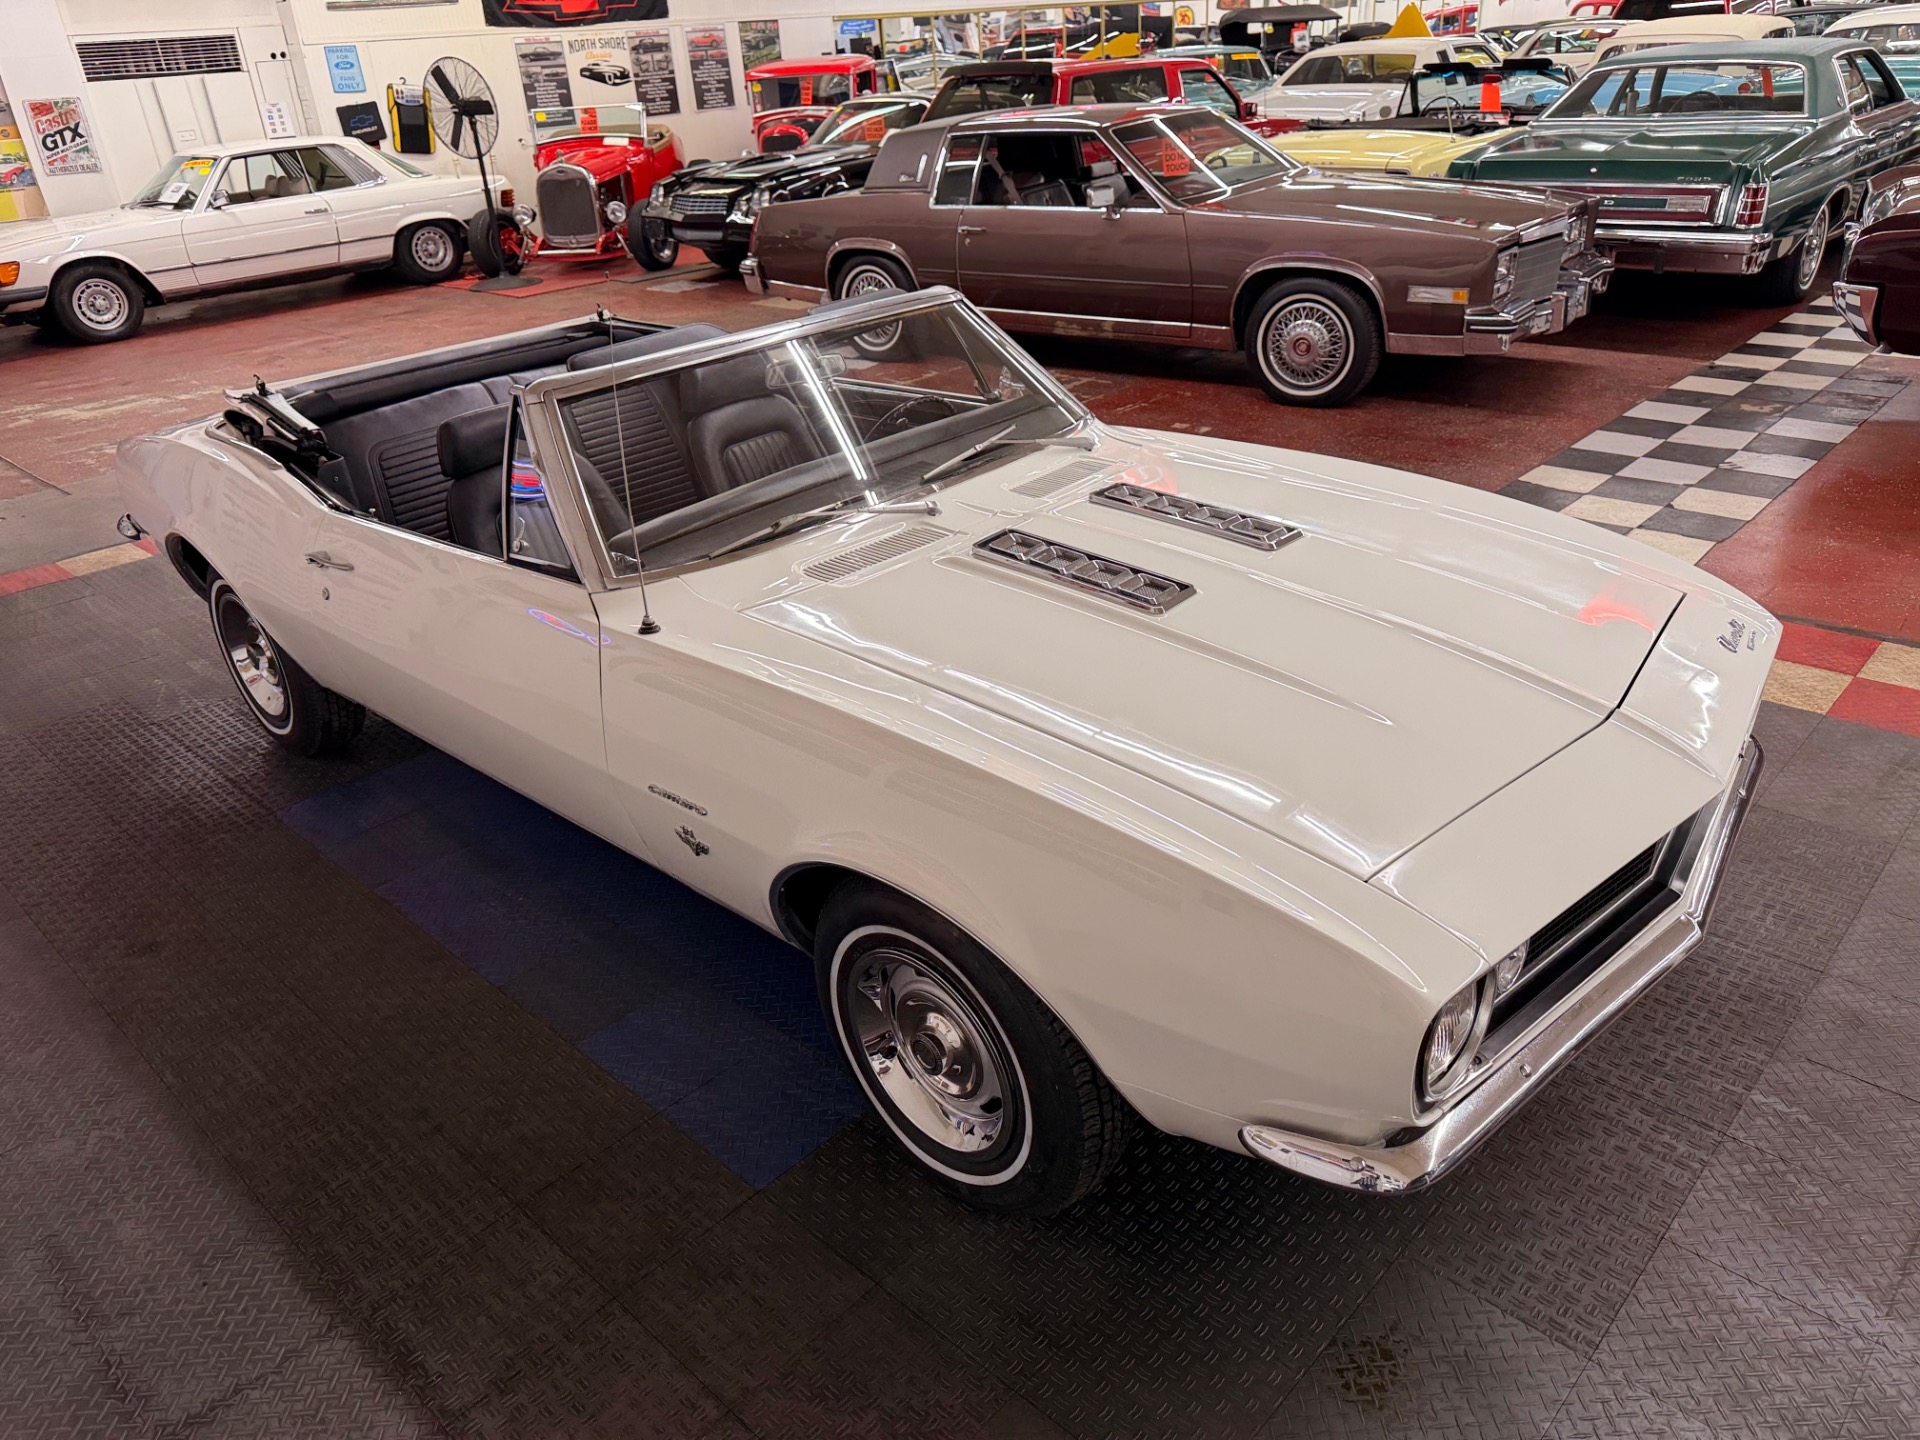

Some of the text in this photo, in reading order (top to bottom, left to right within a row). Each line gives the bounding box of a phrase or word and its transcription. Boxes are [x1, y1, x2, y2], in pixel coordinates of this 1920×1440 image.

[567, 38, 597, 54] NORTH
[597, 36, 627, 50] SHORE
[337, 82, 360, 90] ONLY
[41, 121, 86, 152] GTX
[1165, 153, 1176, 161] DO
[48, 162, 99, 174] AUTHORIZED DEALER
